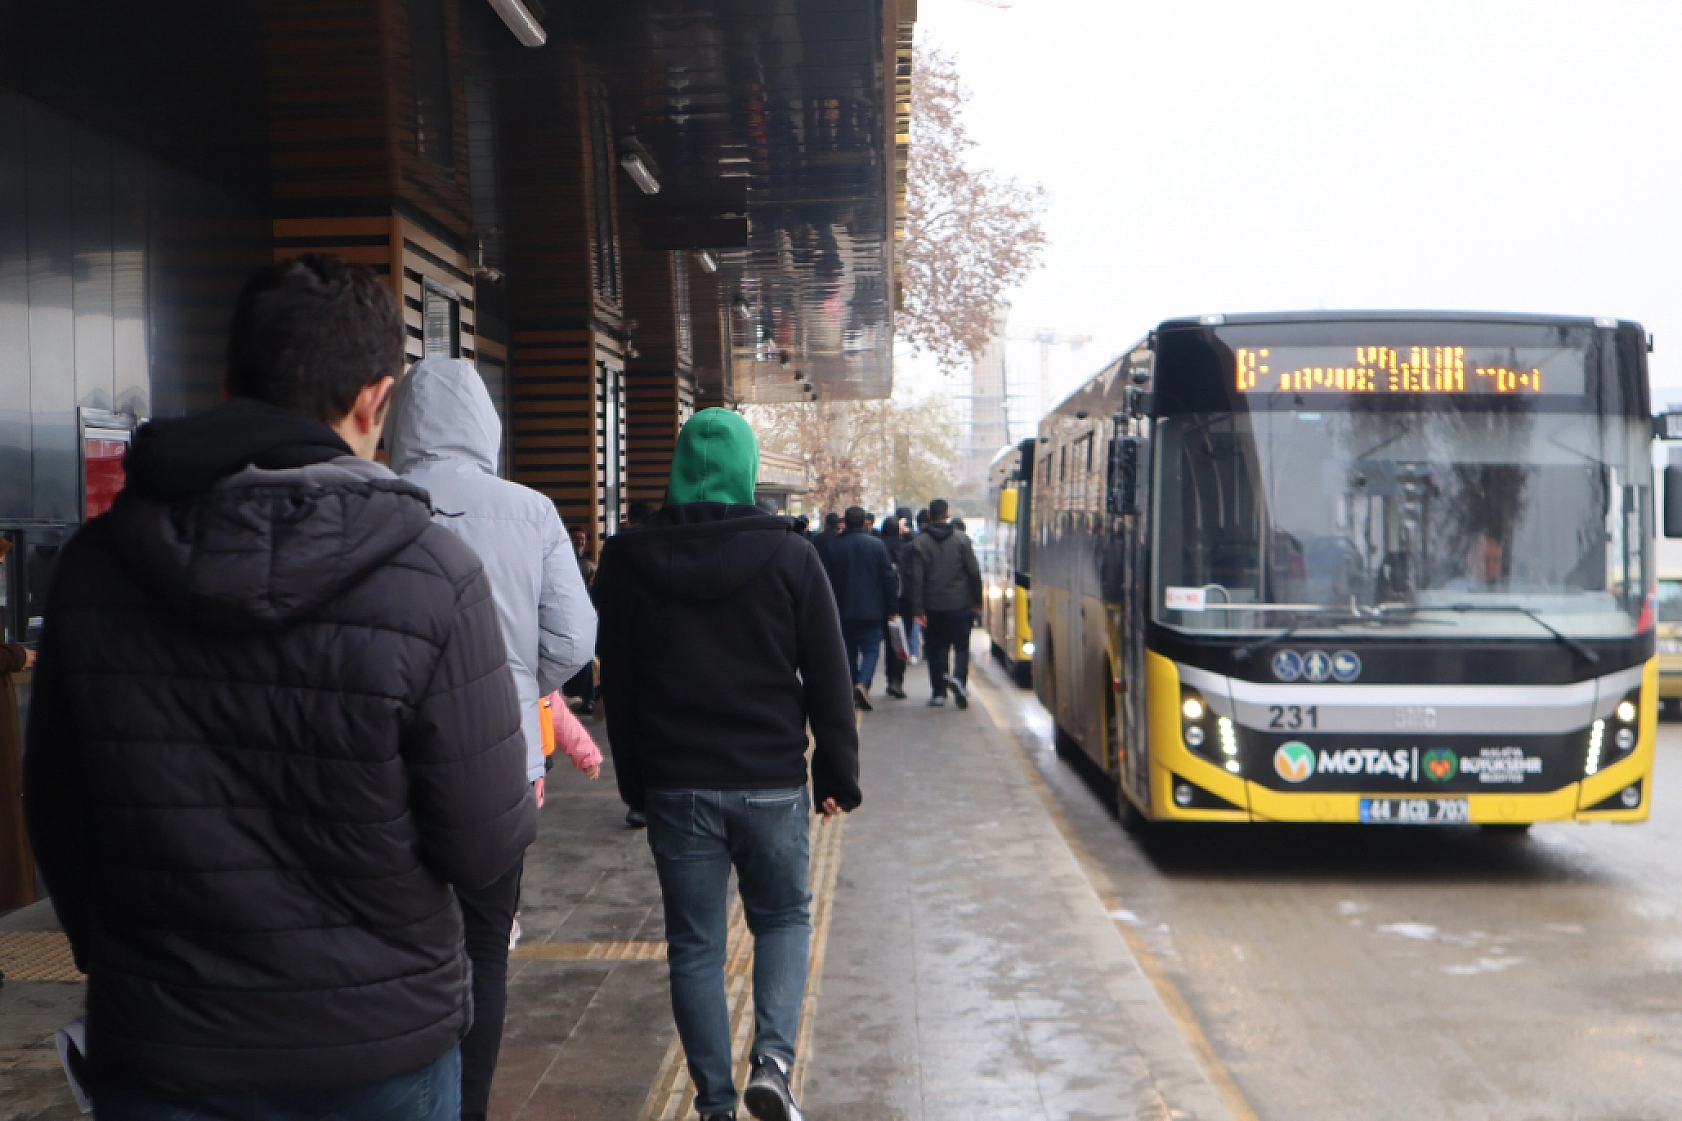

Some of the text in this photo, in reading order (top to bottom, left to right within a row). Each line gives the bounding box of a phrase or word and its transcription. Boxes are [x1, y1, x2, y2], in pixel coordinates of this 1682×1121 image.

[1269, 705, 1318, 728] 231
[1317, 749, 1410, 779] MOTAŞ
[1370, 799, 1392, 820] 44
